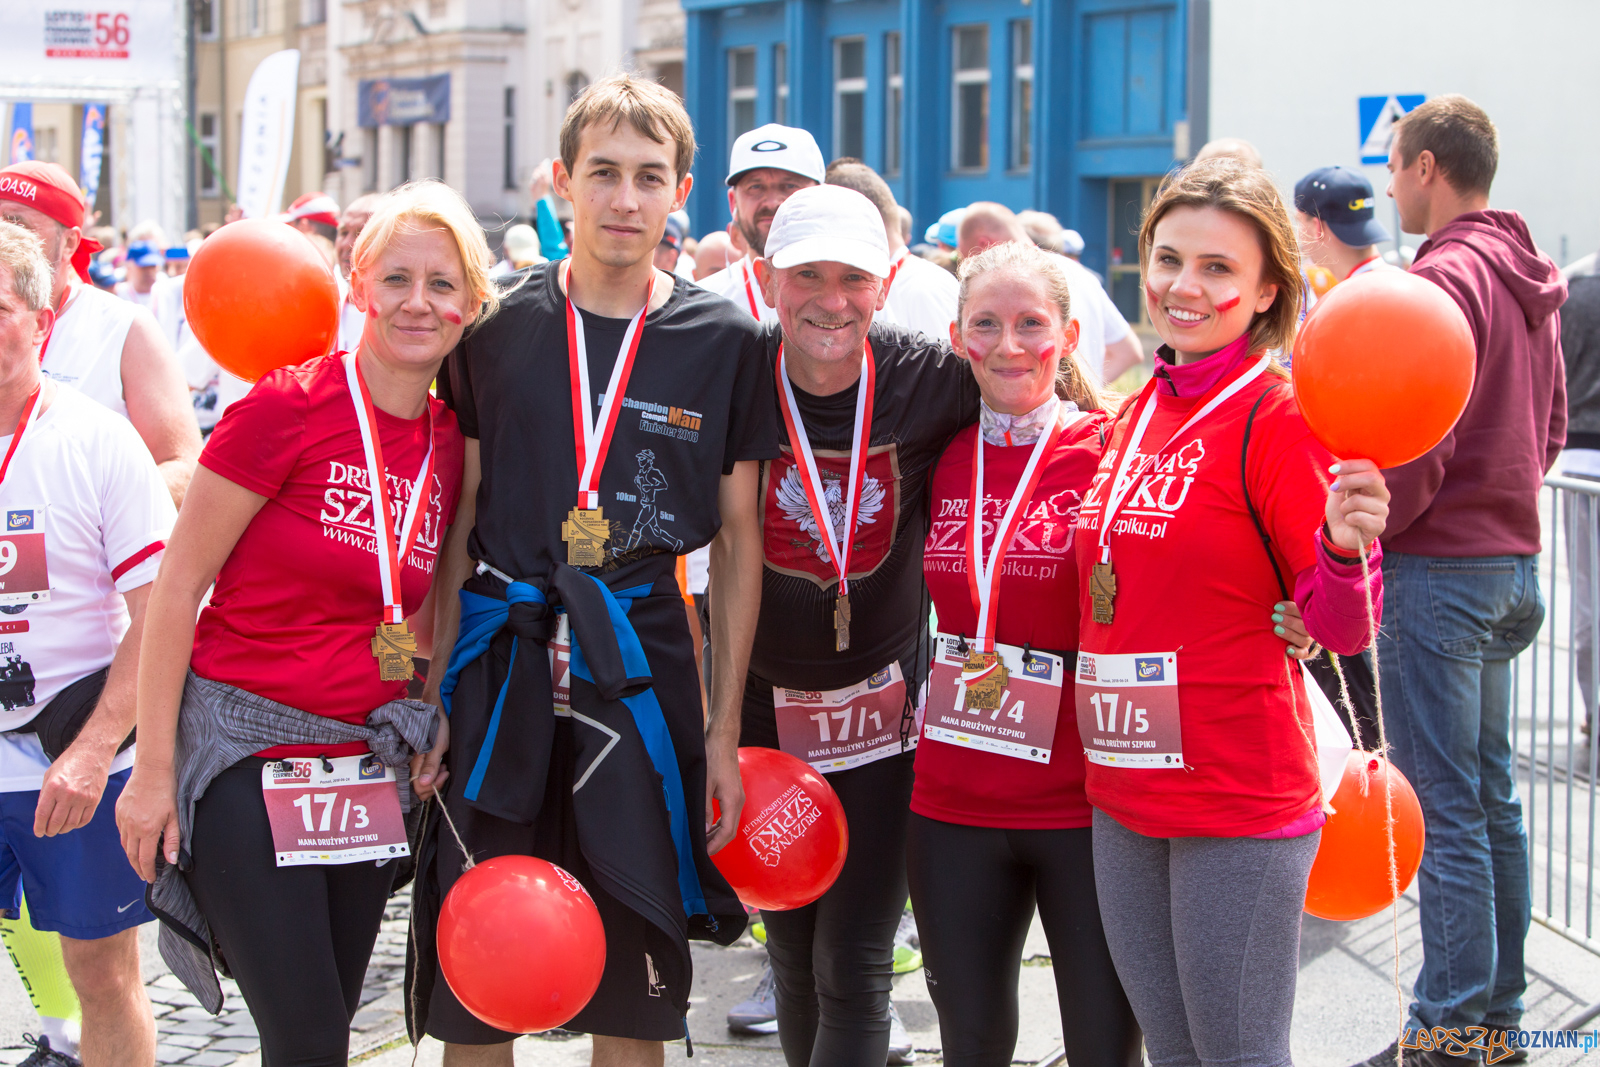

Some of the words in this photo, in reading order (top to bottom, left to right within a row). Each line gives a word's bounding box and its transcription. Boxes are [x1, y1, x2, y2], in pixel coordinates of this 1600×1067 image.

[621, 396, 669, 416] Champion
[667, 406, 703, 431] Man
[639, 419, 678, 437] Finisher
[677, 428, 700, 443] 2018
[615, 491, 637, 502] 10km
[659, 511, 676, 521] 5km
[1031, 663, 1046, 671] LOTTO
[1142, 666, 1158, 675] LOTTO
[954, 677, 1025, 723] 1/4
[809, 706, 883, 742] 17/1
[1090, 692, 1150, 736] 17/5
[940, 715, 959, 726] MANA
[960, 719, 997, 733] DRUŻYNY
[997, 727, 1026, 739] SZPIKU
[808, 749, 831, 758] MANA
[831, 741, 866, 754] DRUŻYNY
[866, 733, 893, 747] SZPIKU
[1093, 738, 1106, 747] MANA
[1106, 738, 1131, 749] DRUŻYNY
[1131, 740, 1157, 749] SZPIKU
[293, 792, 370, 833] 17/3
[742, 784, 799, 836] www.darszpiku.pl
[749, 789, 813, 857] SZPIKU
[770, 805, 823, 854] DRUŻYNA
[297, 838, 318, 846] MANA
[318, 836, 349, 846] DRUŻYNY
[350, 833, 379, 844] SZPIKU
